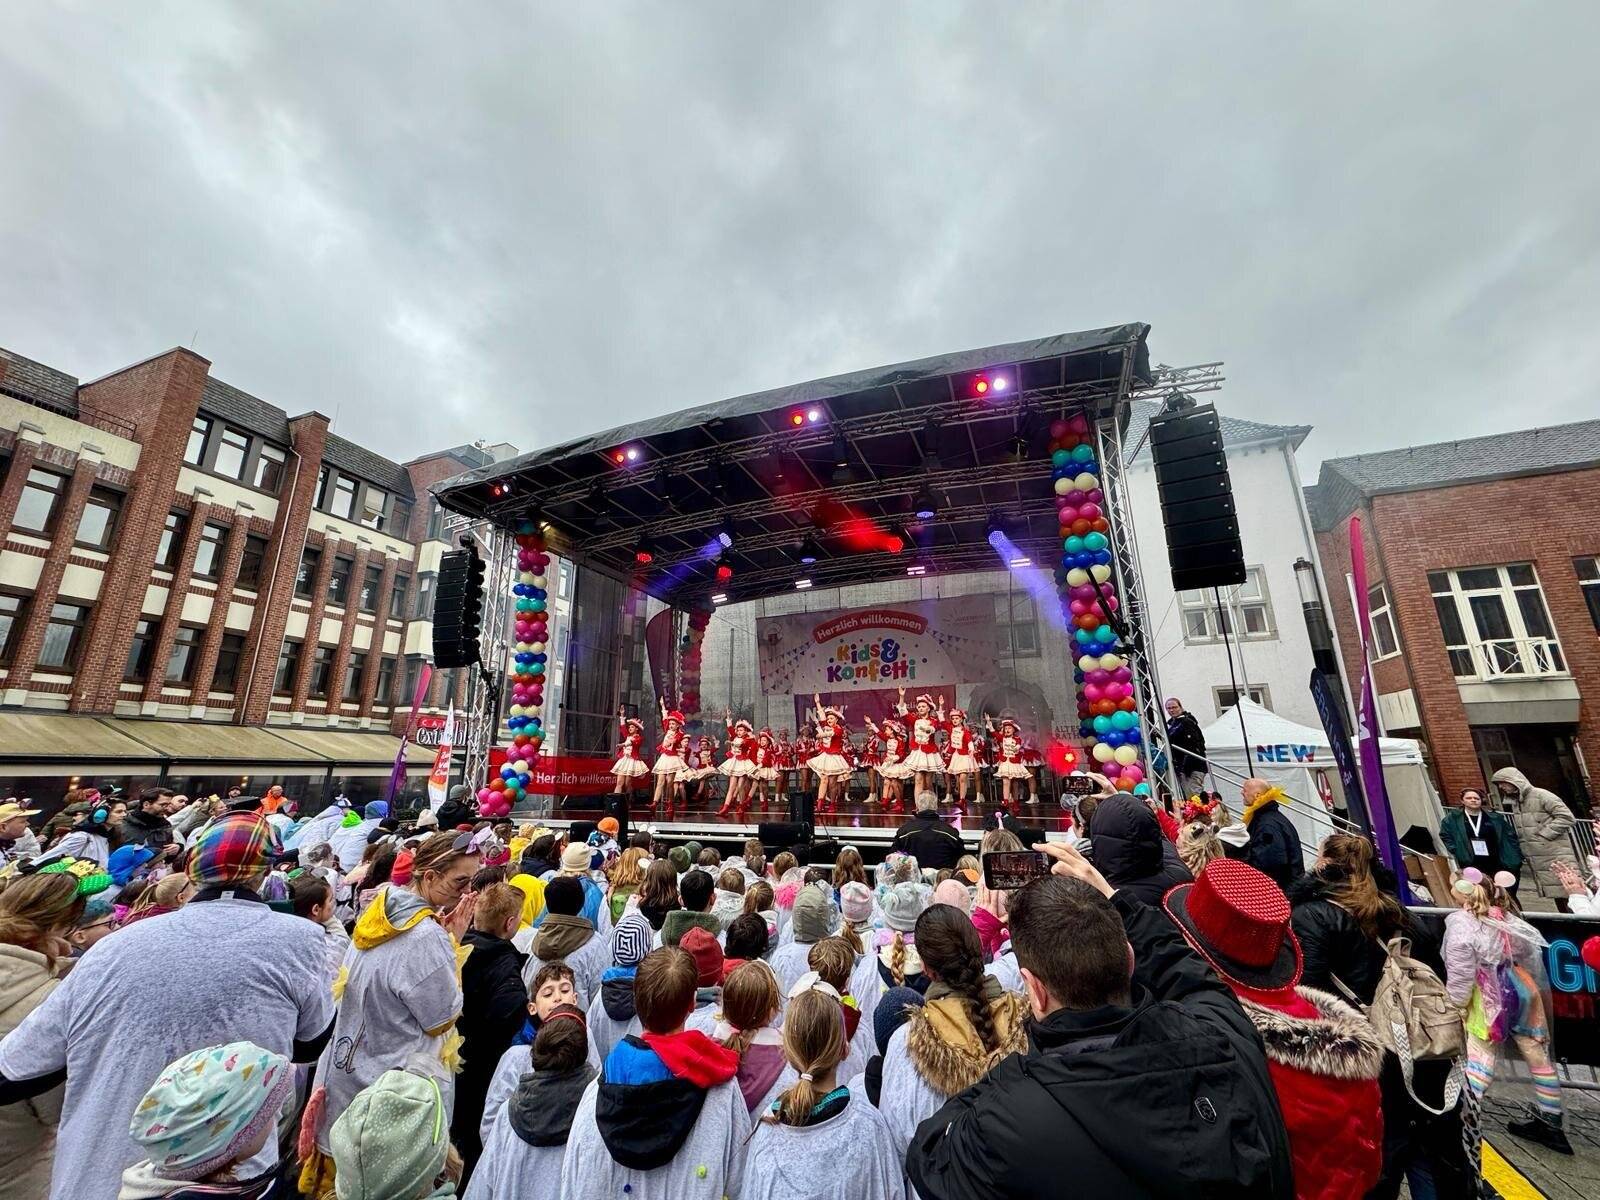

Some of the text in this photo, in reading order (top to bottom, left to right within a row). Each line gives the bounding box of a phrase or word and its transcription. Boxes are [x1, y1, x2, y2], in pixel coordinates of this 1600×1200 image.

[817, 614, 922, 640] Herzlich willkommen
[827, 659, 916, 682] Konfetti
[1257, 744, 1317, 763] NEW
[536, 771, 578, 784] Herzlich
